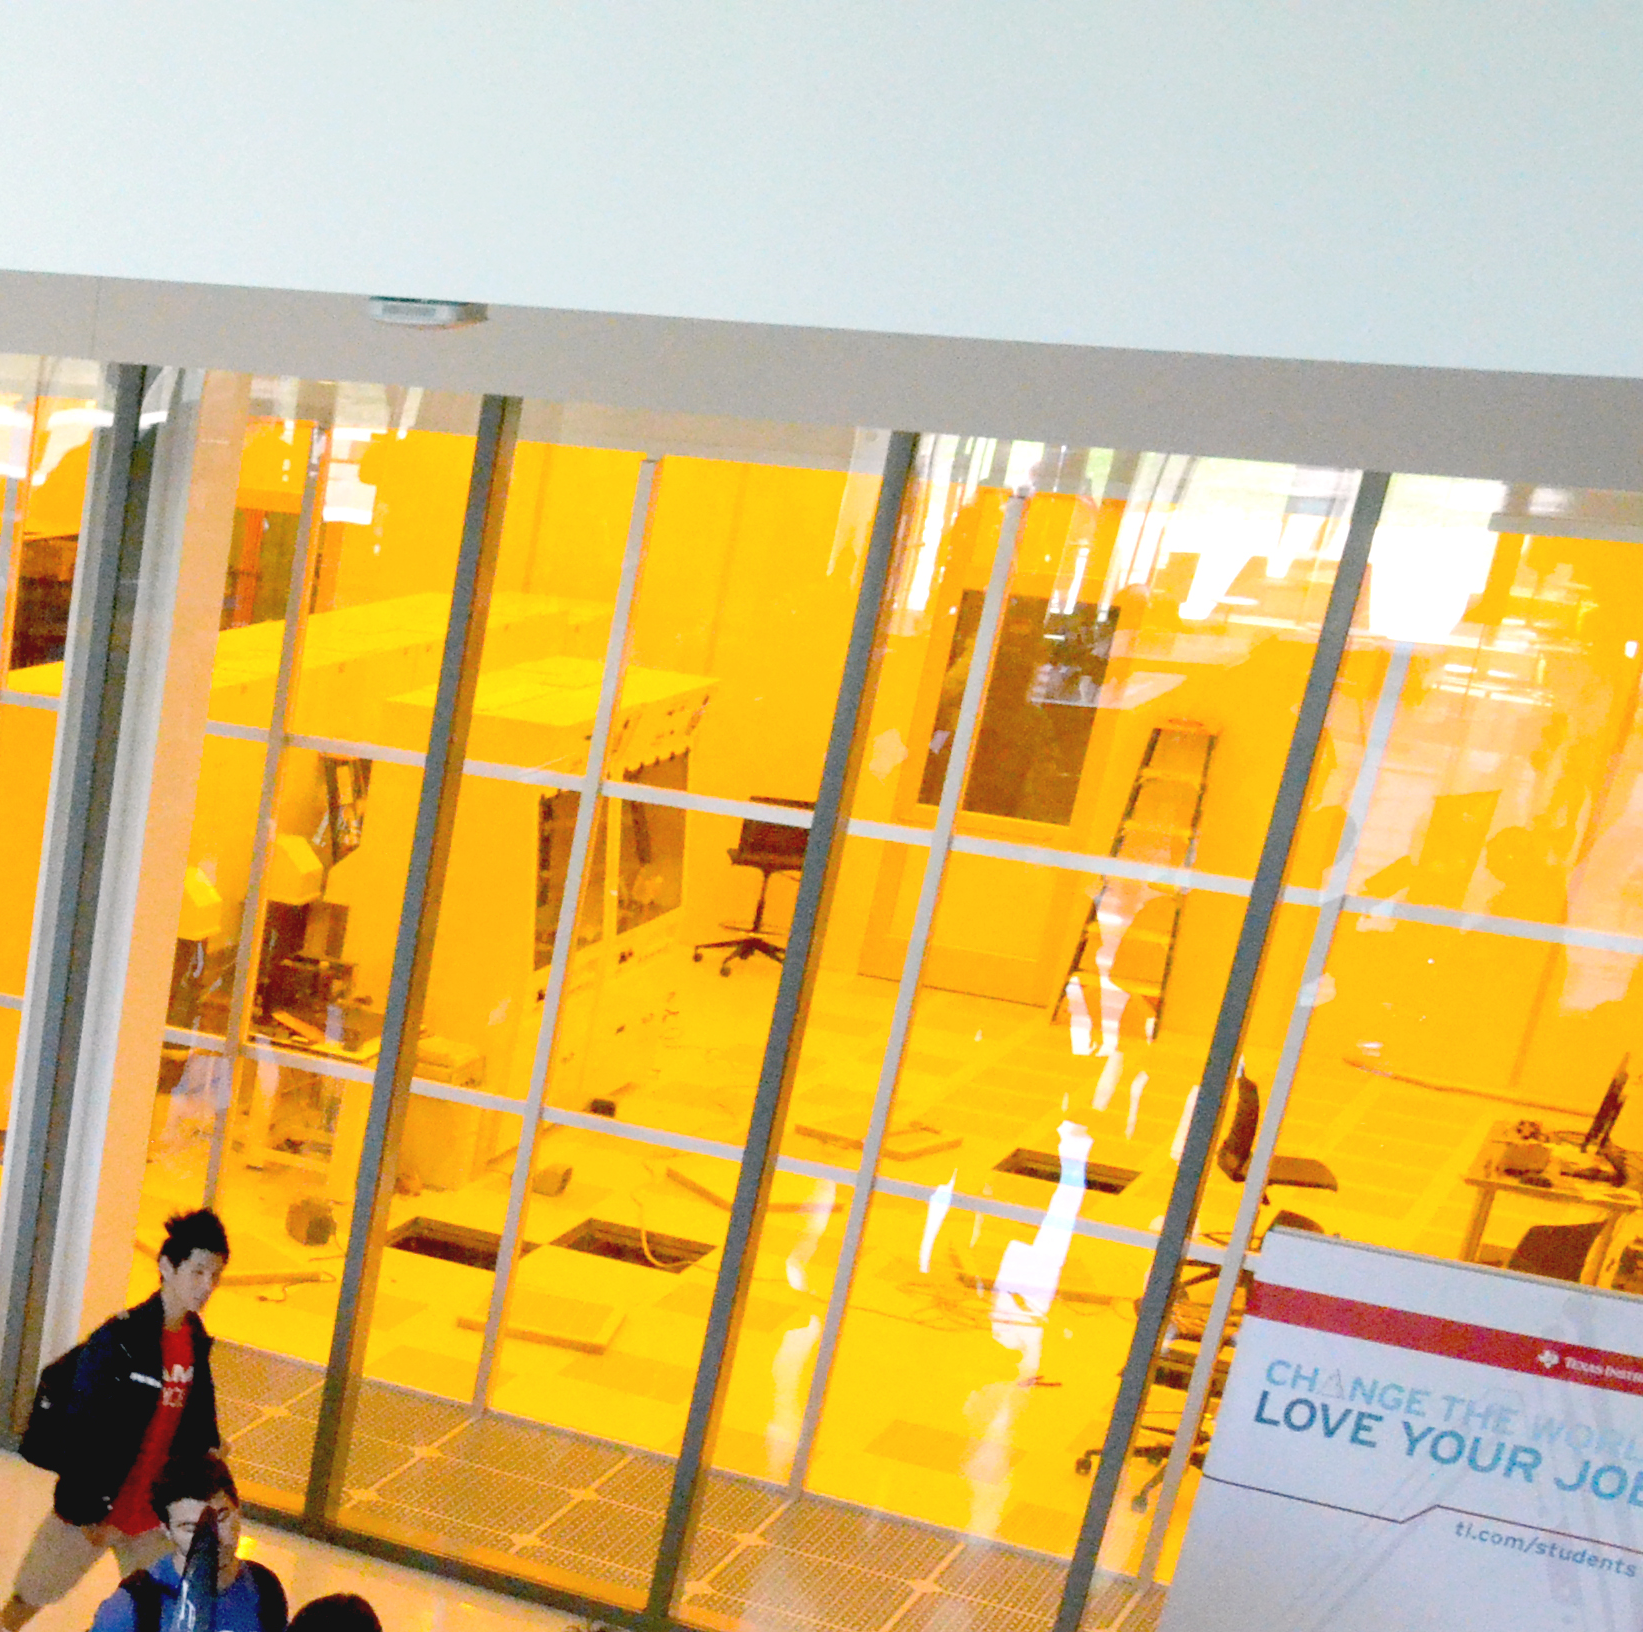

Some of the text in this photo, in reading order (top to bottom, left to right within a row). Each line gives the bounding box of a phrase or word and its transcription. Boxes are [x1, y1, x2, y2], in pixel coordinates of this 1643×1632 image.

[1254, 1390, 1384, 1448] LOVE
[1402, 1421, 1543, 1483] YOUR
[1442, 1395, 1519, 1435] THE
